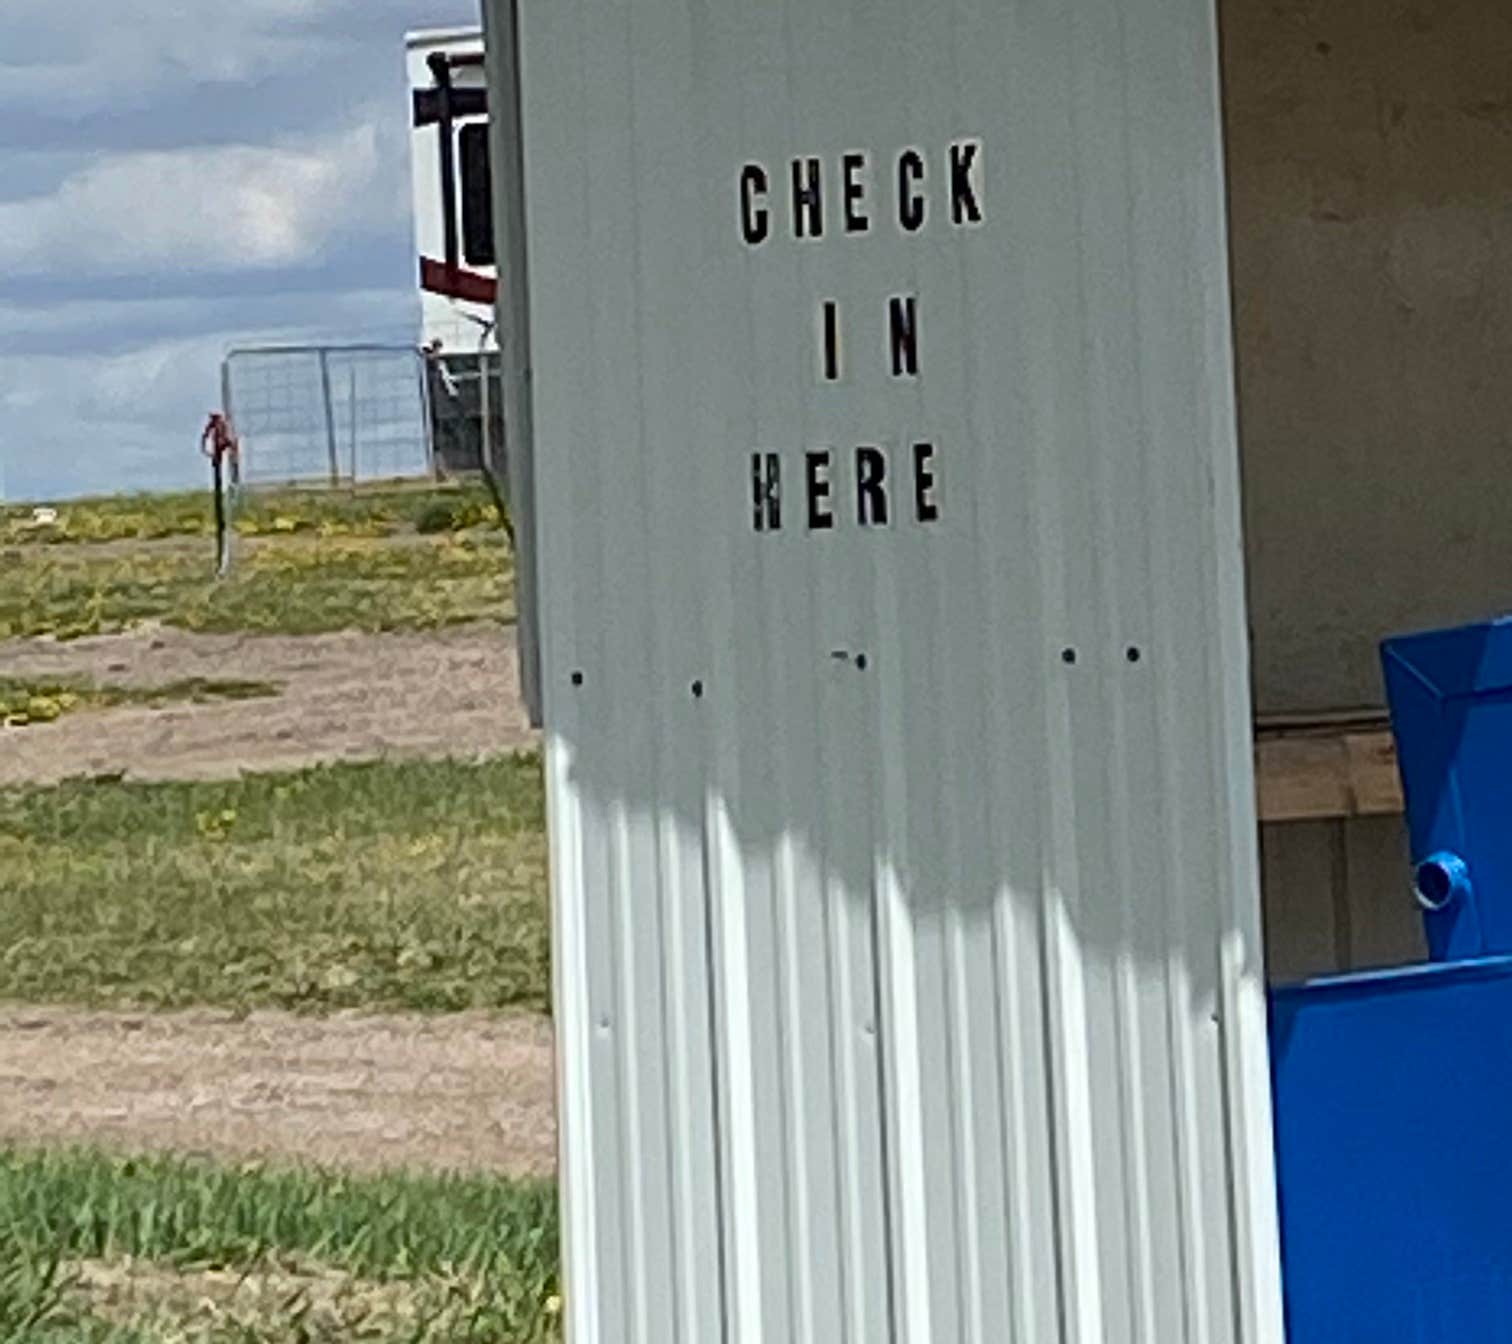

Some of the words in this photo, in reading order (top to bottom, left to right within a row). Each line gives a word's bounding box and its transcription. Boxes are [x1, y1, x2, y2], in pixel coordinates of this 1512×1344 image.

[739, 144, 982, 244] CHECK
[823, 297, 918, 380] IN
[751, 442, 939, 532] HERE
